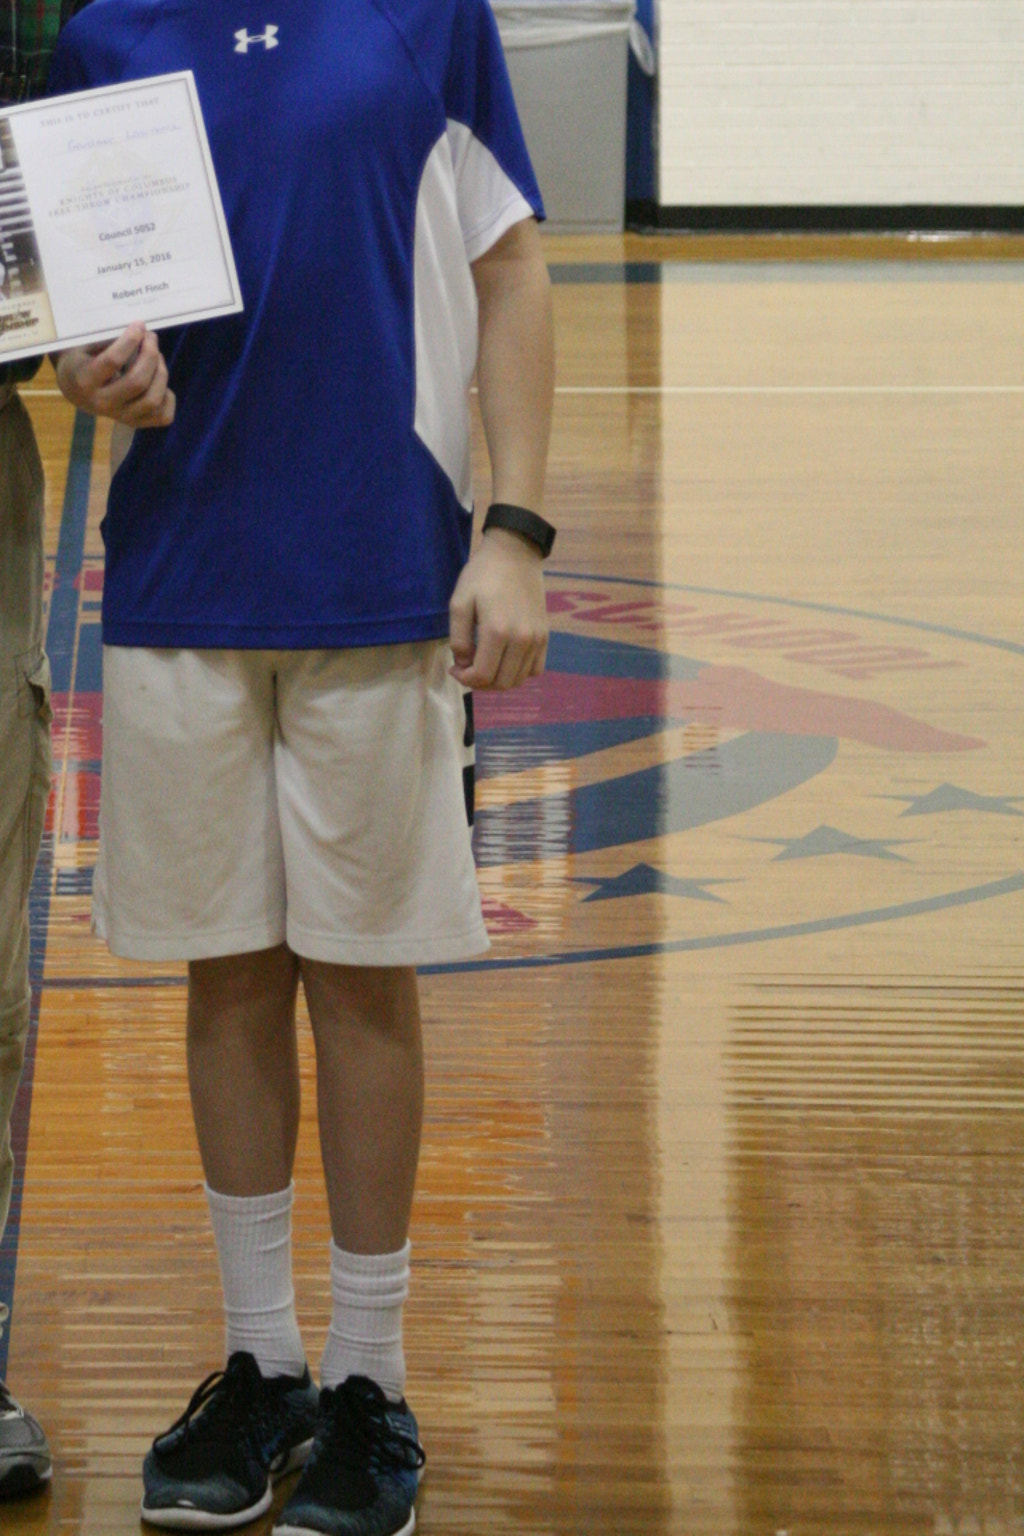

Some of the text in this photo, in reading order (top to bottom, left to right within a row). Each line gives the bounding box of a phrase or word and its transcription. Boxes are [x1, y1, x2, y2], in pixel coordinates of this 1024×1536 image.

[99, 222, 156, 242] Council 5052
[97, 261, 133, 275] January
[134, 256, 149, 267] 15,
[150, 251, 173, 264] 2016
[112, 281, 170, 301] Robert Finch
